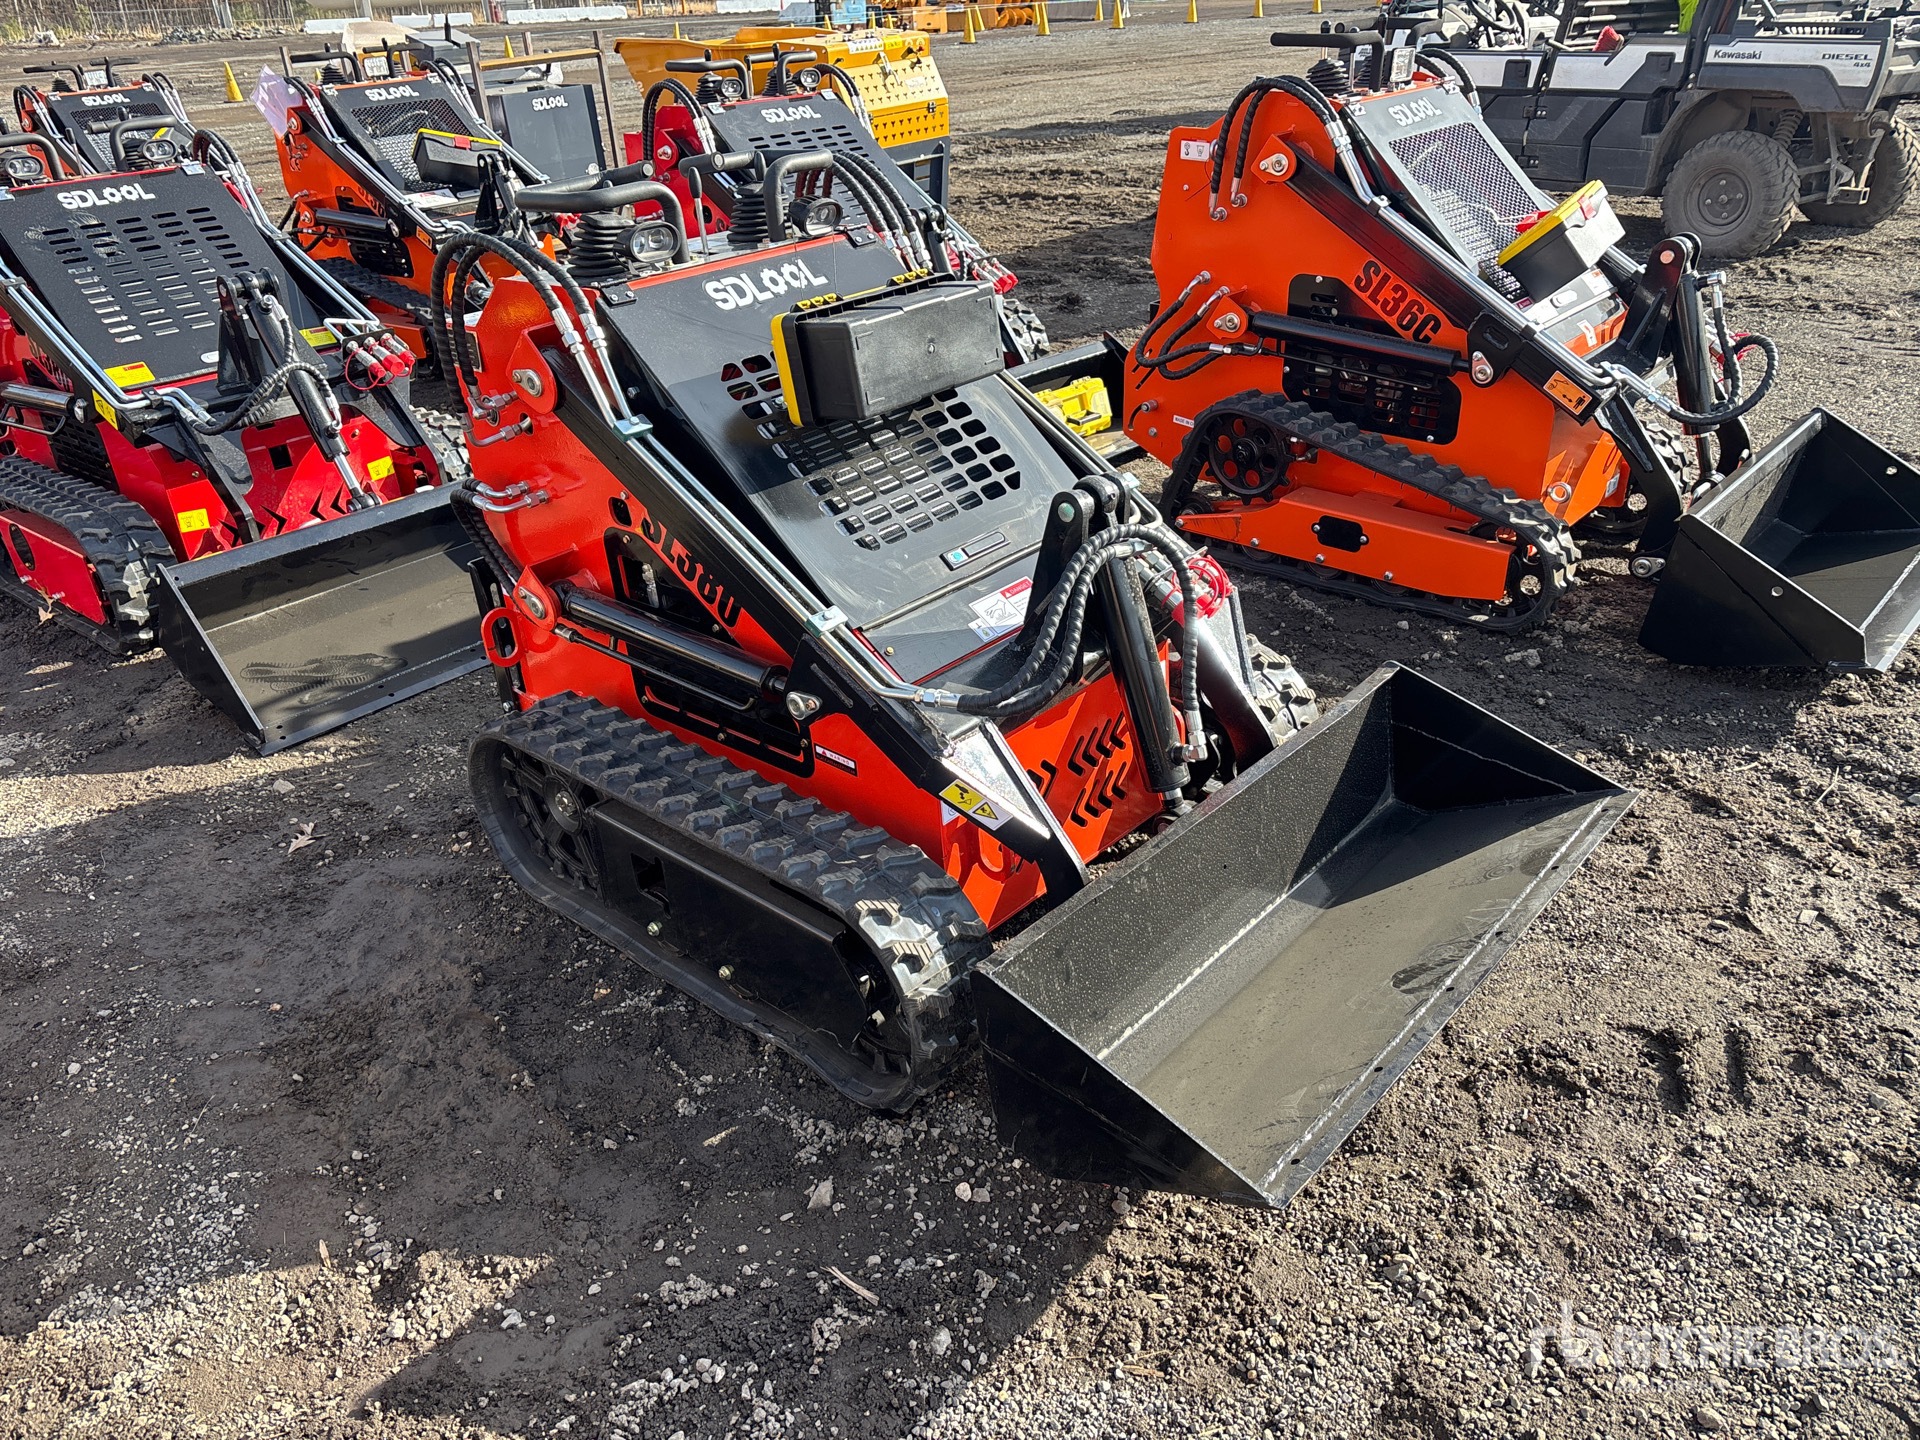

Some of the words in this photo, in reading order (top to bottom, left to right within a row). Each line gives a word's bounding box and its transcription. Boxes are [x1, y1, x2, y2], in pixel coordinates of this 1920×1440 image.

[1713, 50, 1762, 60] Kawasaki
[1821, 53, 1873, 61] DIESEL
[81, 92, 131, 107] SDLOOL
[364, 84, 420, 101] SDLOOL
[531, 94, 569, 111] SDLOOL
[1387, 96, 1443, 127] SDLOOL
[760, 104, 822, 123] SDLOOL
[57, 182, 156, 210] SDLOOL
[704, 258, 829, 310] SDLOOL
[1354, 259, 1442, 344] SL36C
